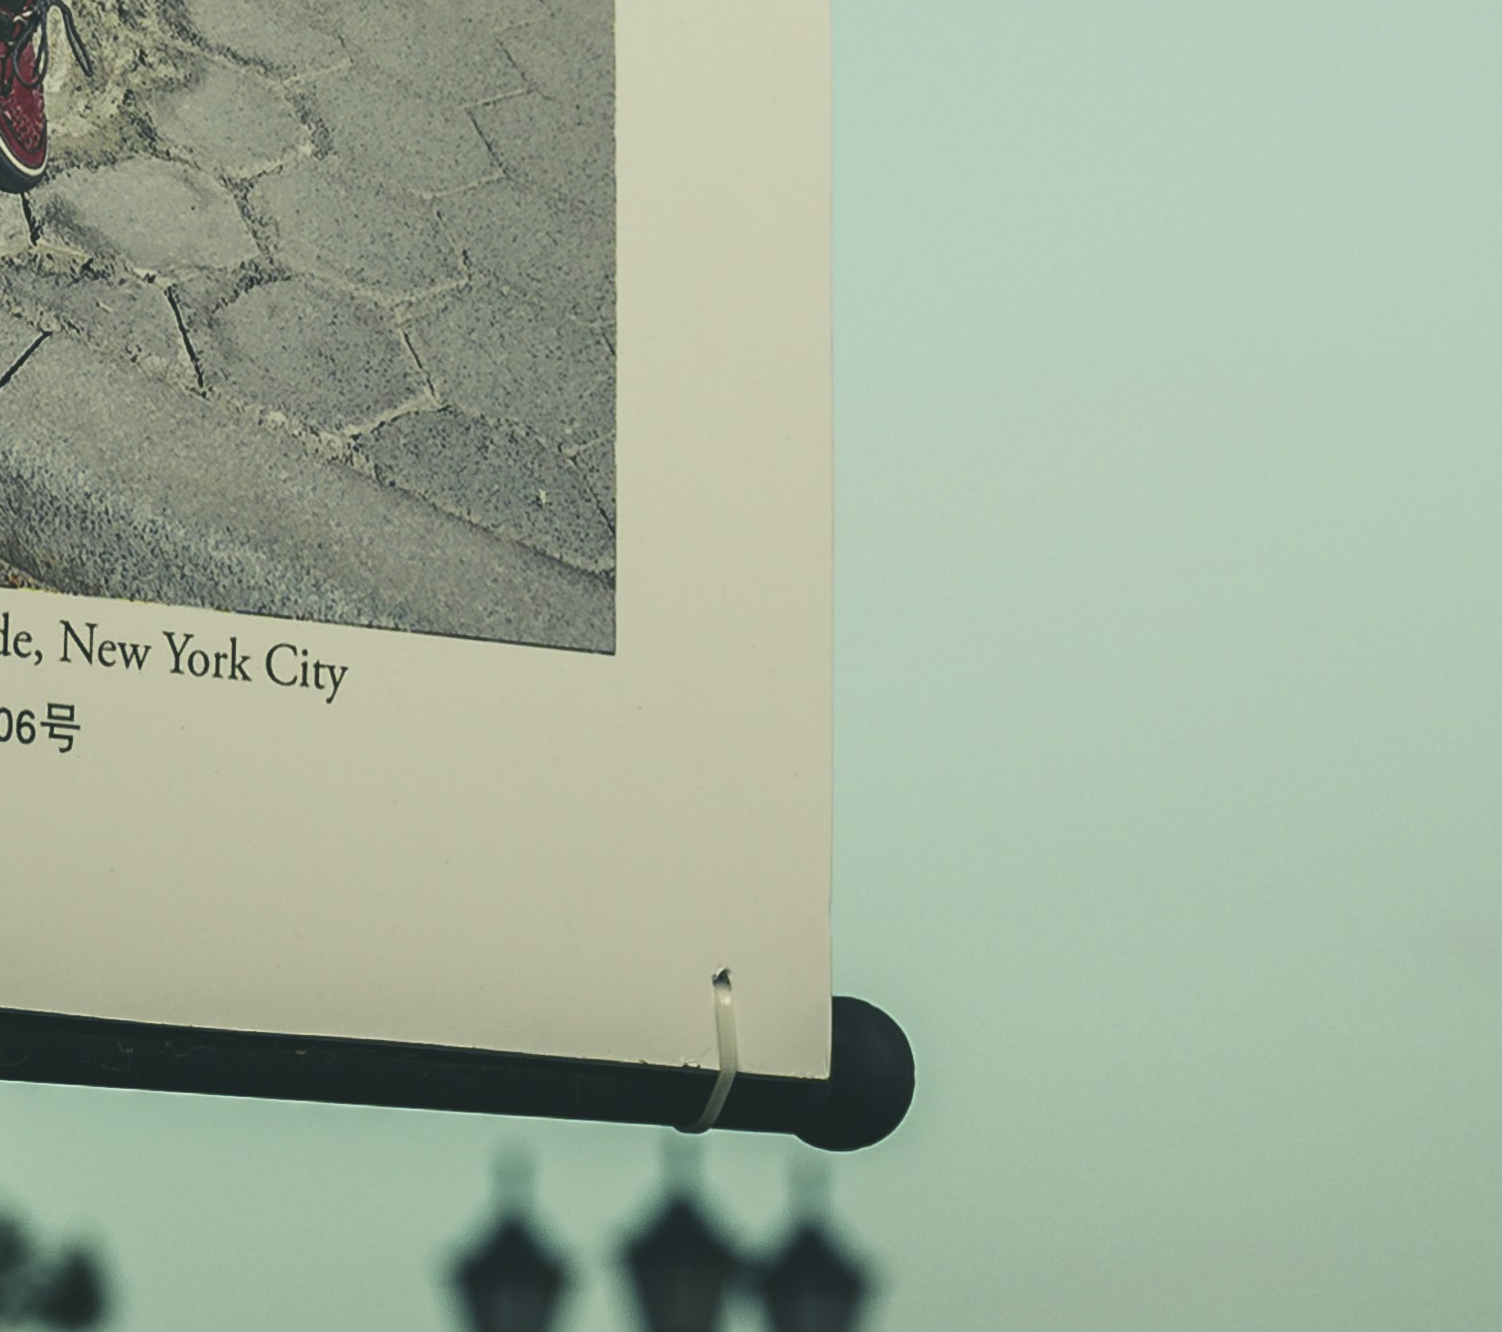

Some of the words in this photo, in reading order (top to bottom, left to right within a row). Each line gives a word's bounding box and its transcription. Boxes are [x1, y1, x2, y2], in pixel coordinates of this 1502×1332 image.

[58, 619, 153, 672] New
[161, 630, 254, 683] York
[264, 642, 349, 705] City
